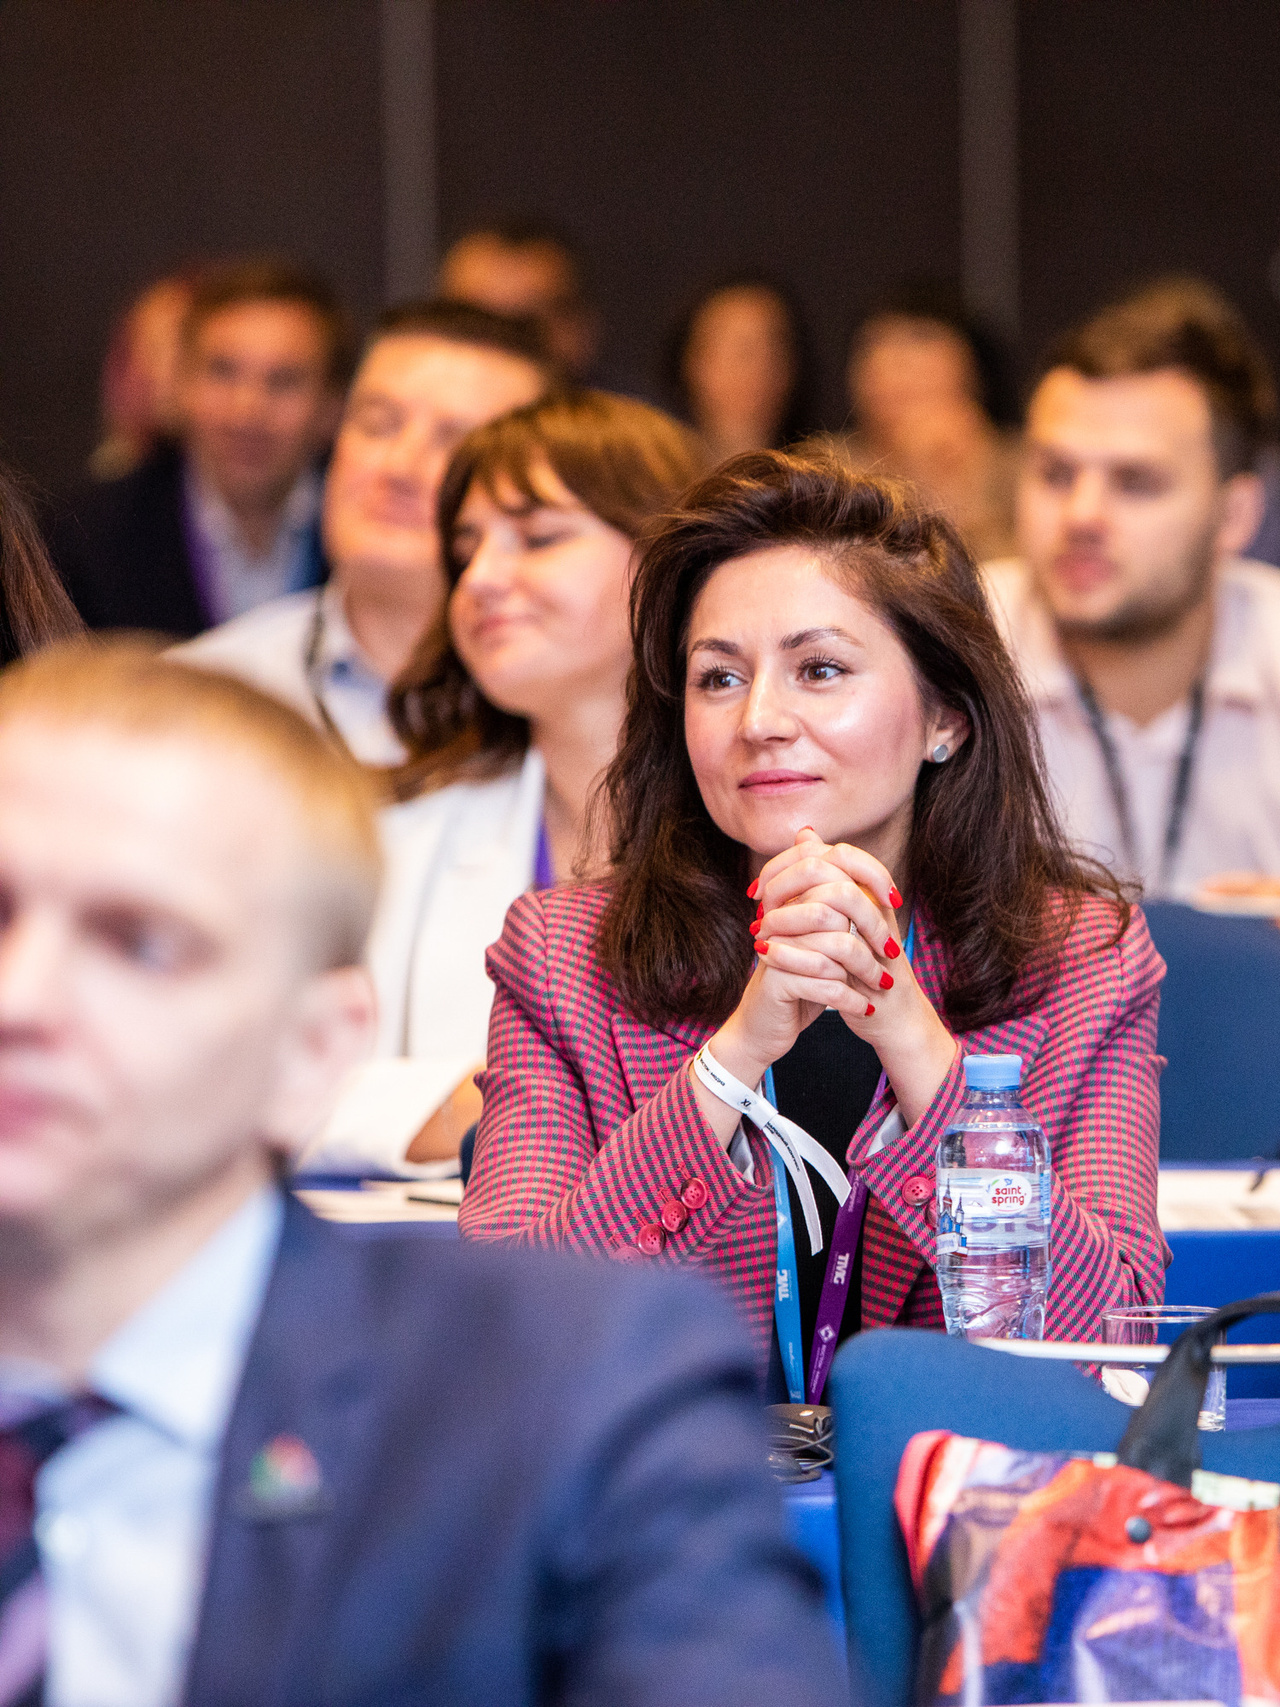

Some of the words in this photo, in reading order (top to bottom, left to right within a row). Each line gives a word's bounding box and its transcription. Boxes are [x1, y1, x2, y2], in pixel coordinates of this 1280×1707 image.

[991, 1194, 1025, 1206] spring
[995, 1186, 1022, 1195] saint
[834, 1253, 849, 1285] TMG
[776, 1269, 789, 1301] TMG
